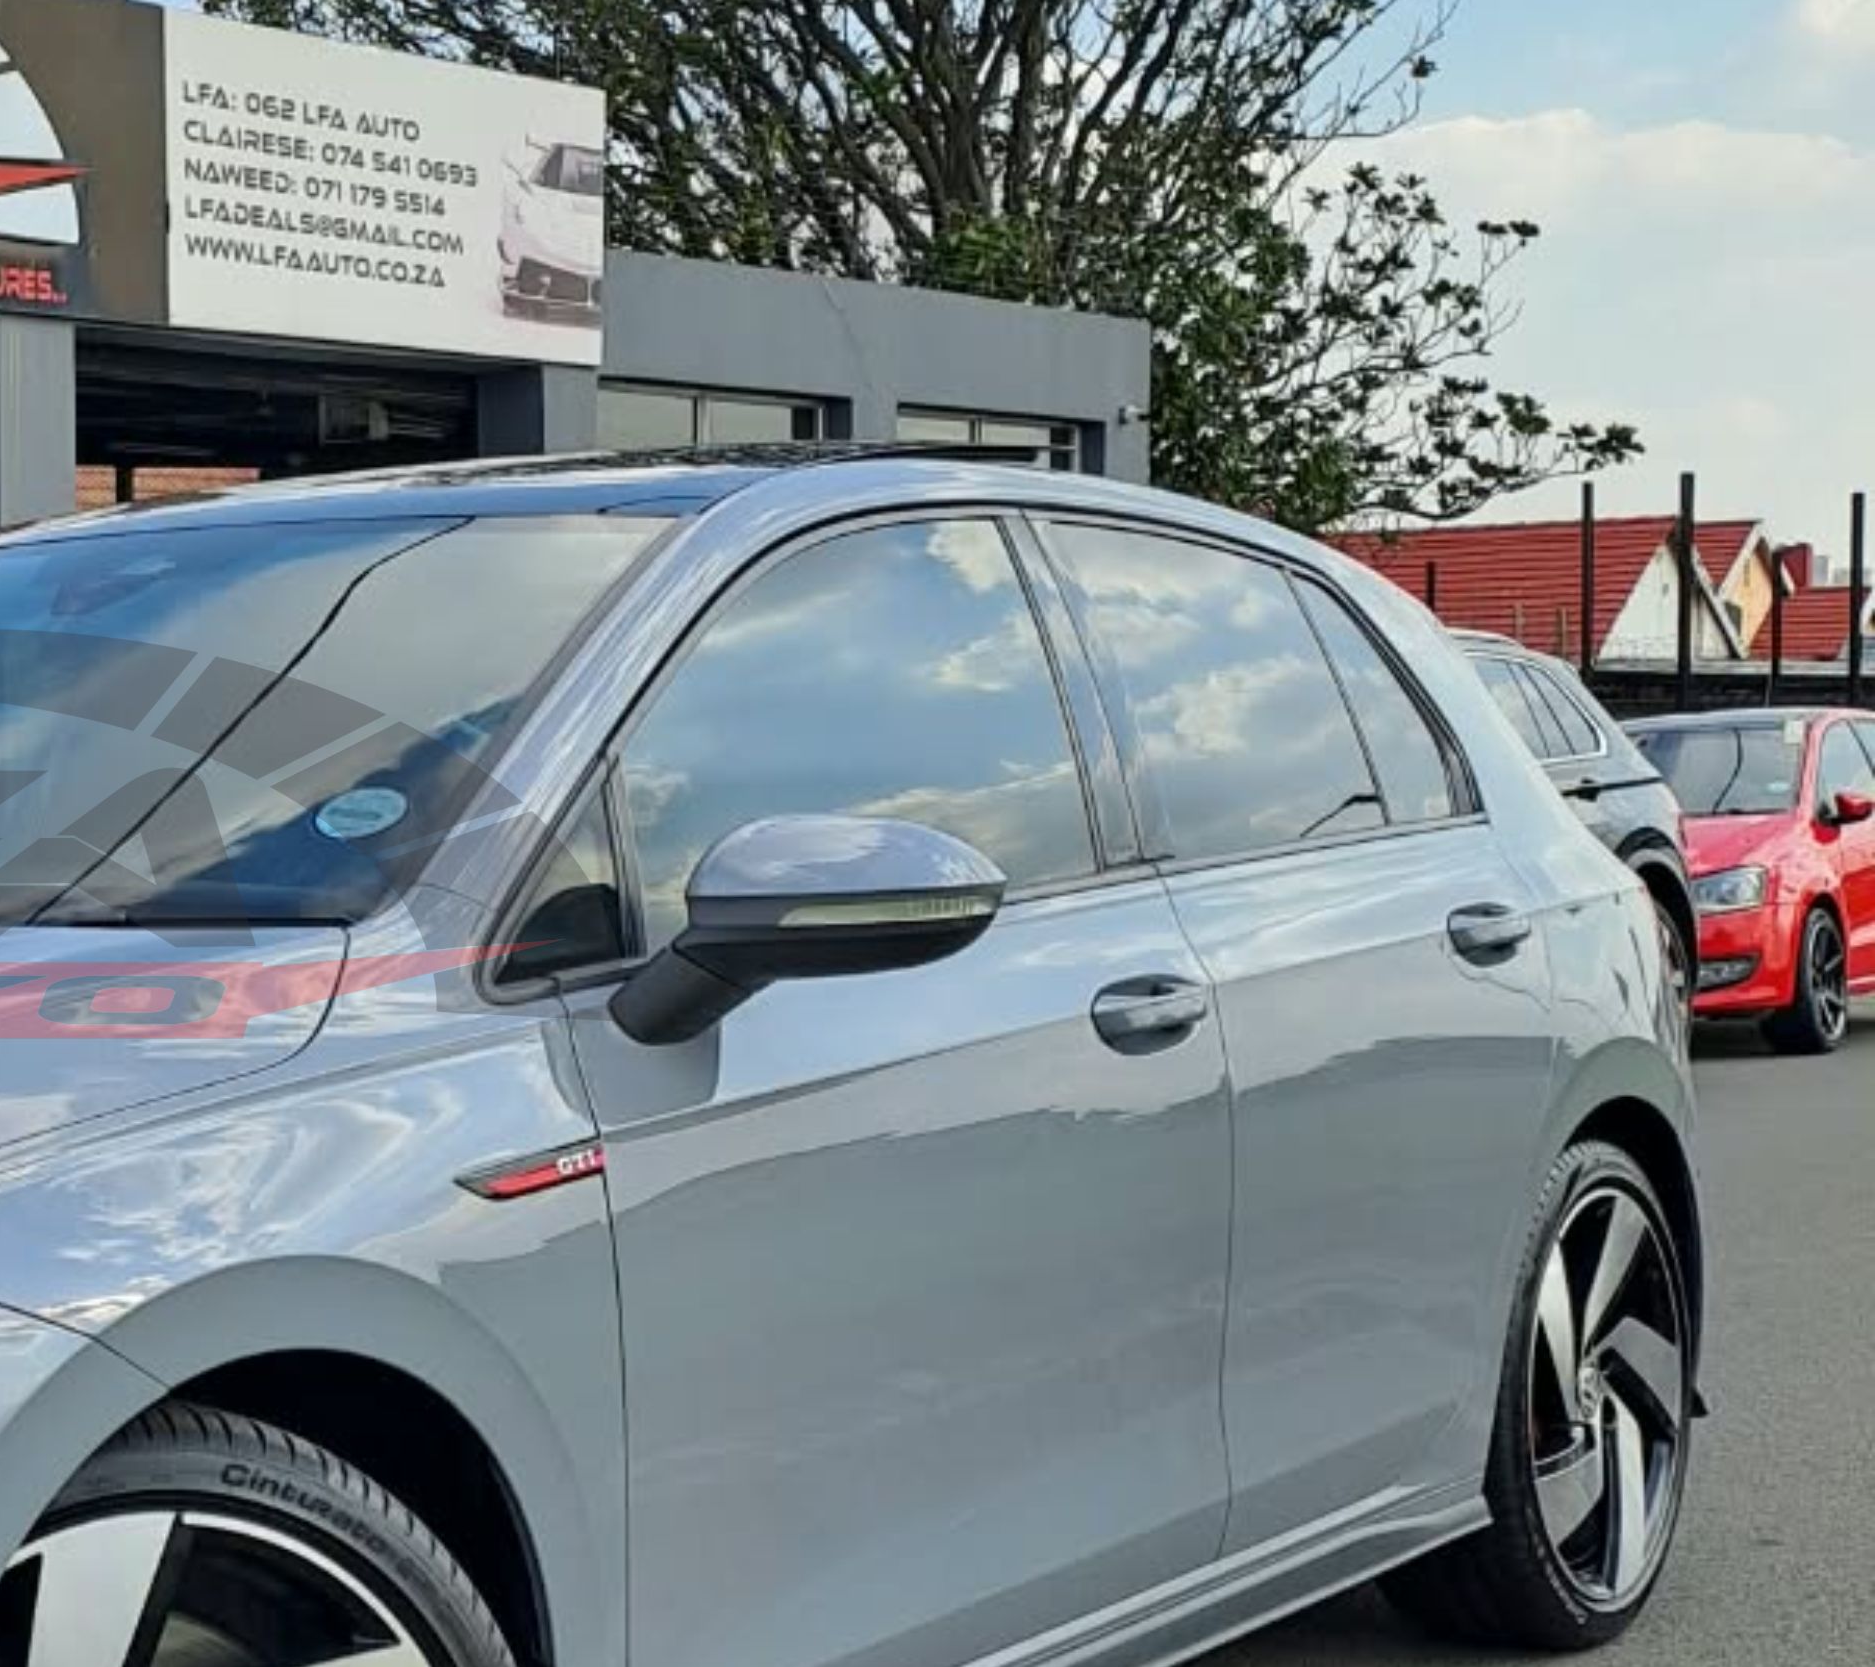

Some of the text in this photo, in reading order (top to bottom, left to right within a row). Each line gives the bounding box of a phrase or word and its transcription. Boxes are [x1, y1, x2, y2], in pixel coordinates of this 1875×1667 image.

[182, 80, 420, 142] LFA: 062 LFA AUTO
[183, 119, 315, 163] CLAIRESE:
[321, 142, 365, 169] 074
[372, 150, 411, 176] 541
[184, 157, 446, 217] NAWEED: 071 179 5514
[184, 193, 464, 256] LFADEALS@GMAIL.COM
[184, 232, 446, 288] WWW.LFAAUTO.CO.ZA
[555, 1148, 596, 1175] GTI
